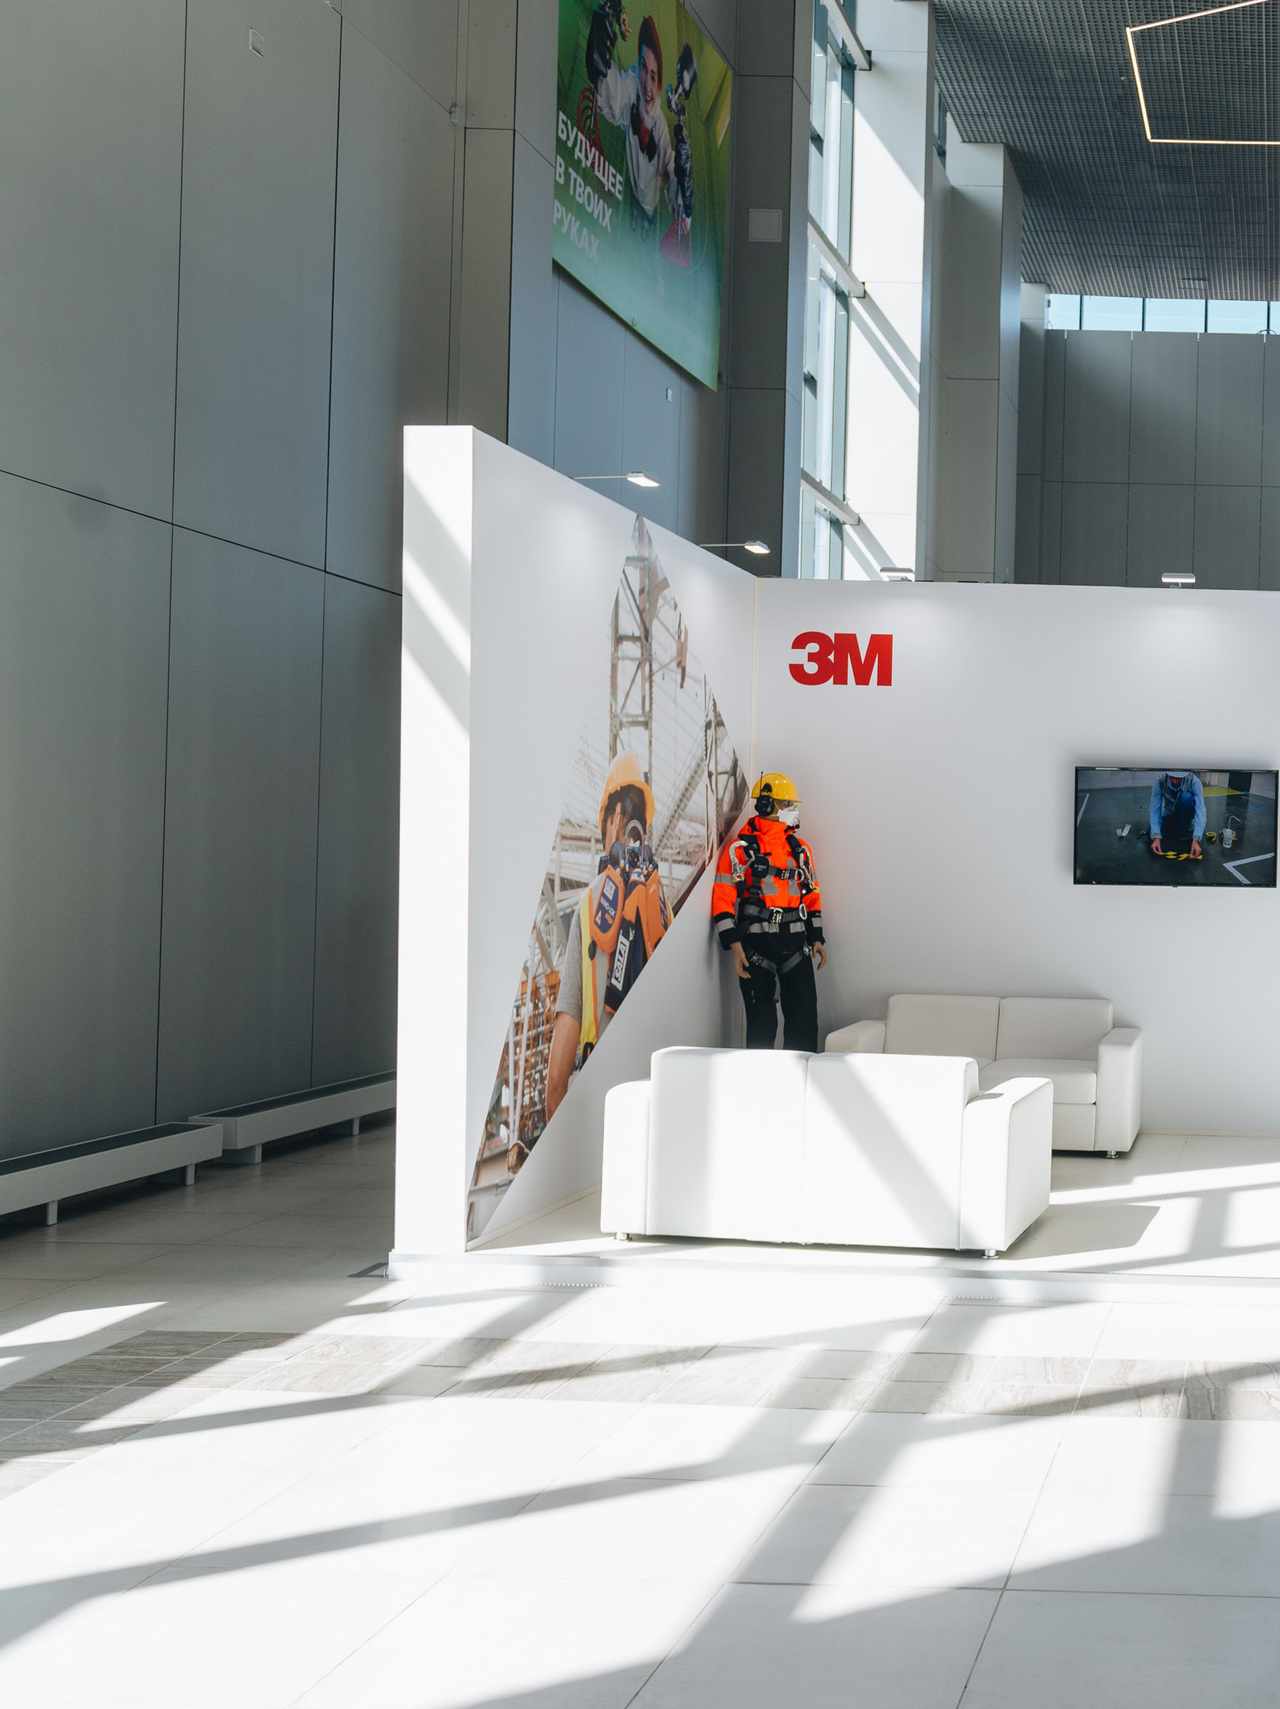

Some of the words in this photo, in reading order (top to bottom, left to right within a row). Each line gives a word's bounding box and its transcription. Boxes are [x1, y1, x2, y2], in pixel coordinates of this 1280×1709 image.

[558, 110, 624, 200] БУДУЩЕЕ
[555, 154, 566, 185] В
[568, 166, 613, 234] ТВОИХ
[553, 199, 600, 264] РУКАХ
[788, 630, 894, 687] 3M
